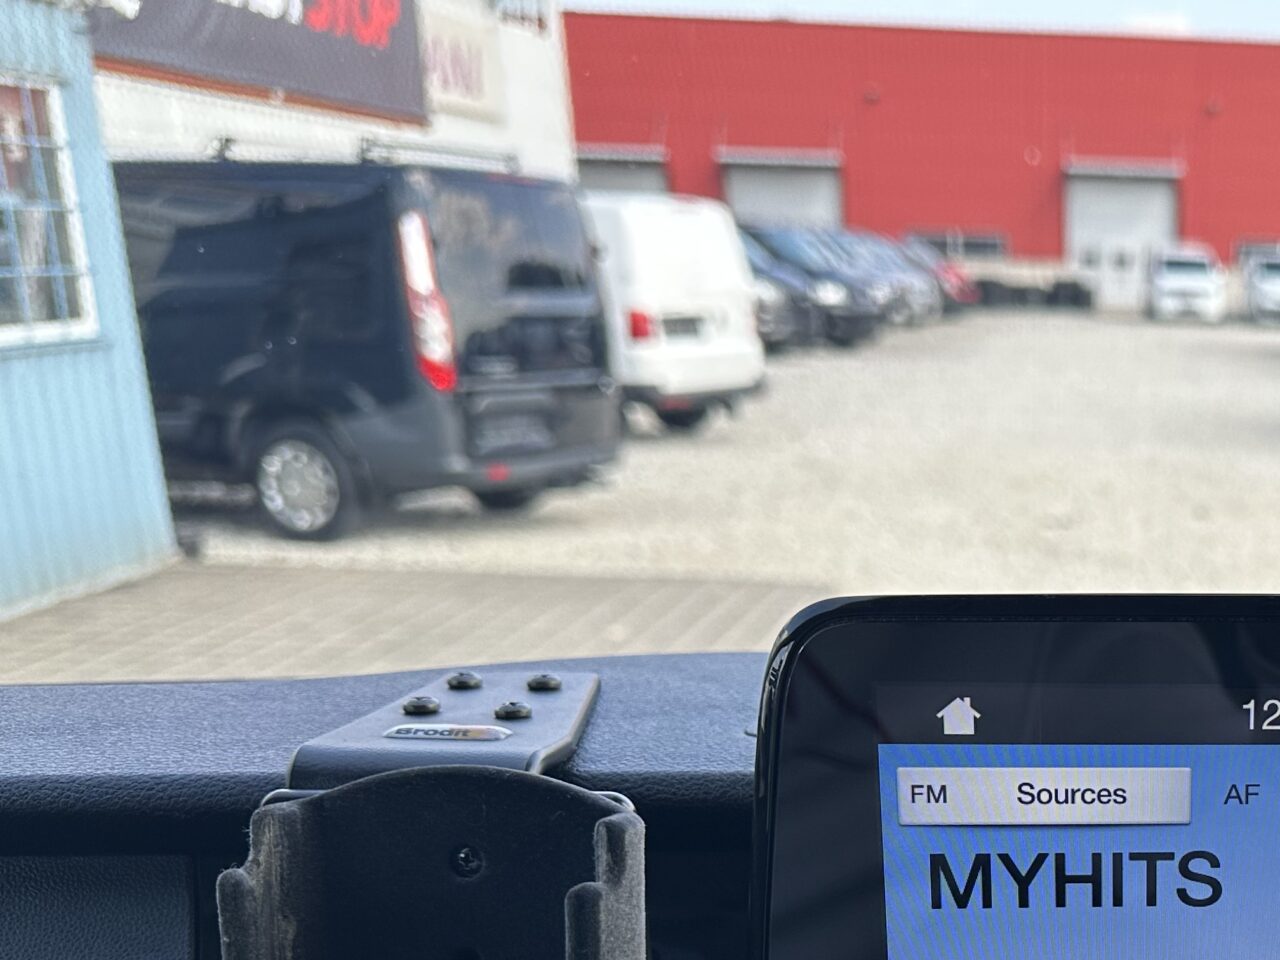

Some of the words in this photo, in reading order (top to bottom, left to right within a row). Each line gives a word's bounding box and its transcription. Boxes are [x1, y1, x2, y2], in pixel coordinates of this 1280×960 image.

[910, 784, 949, 805] FM
[1016, 782, 1128, 806] Sources
[1223, 783, 1262, 806] AF
[928, 850, 1224, 911] MYHITS
